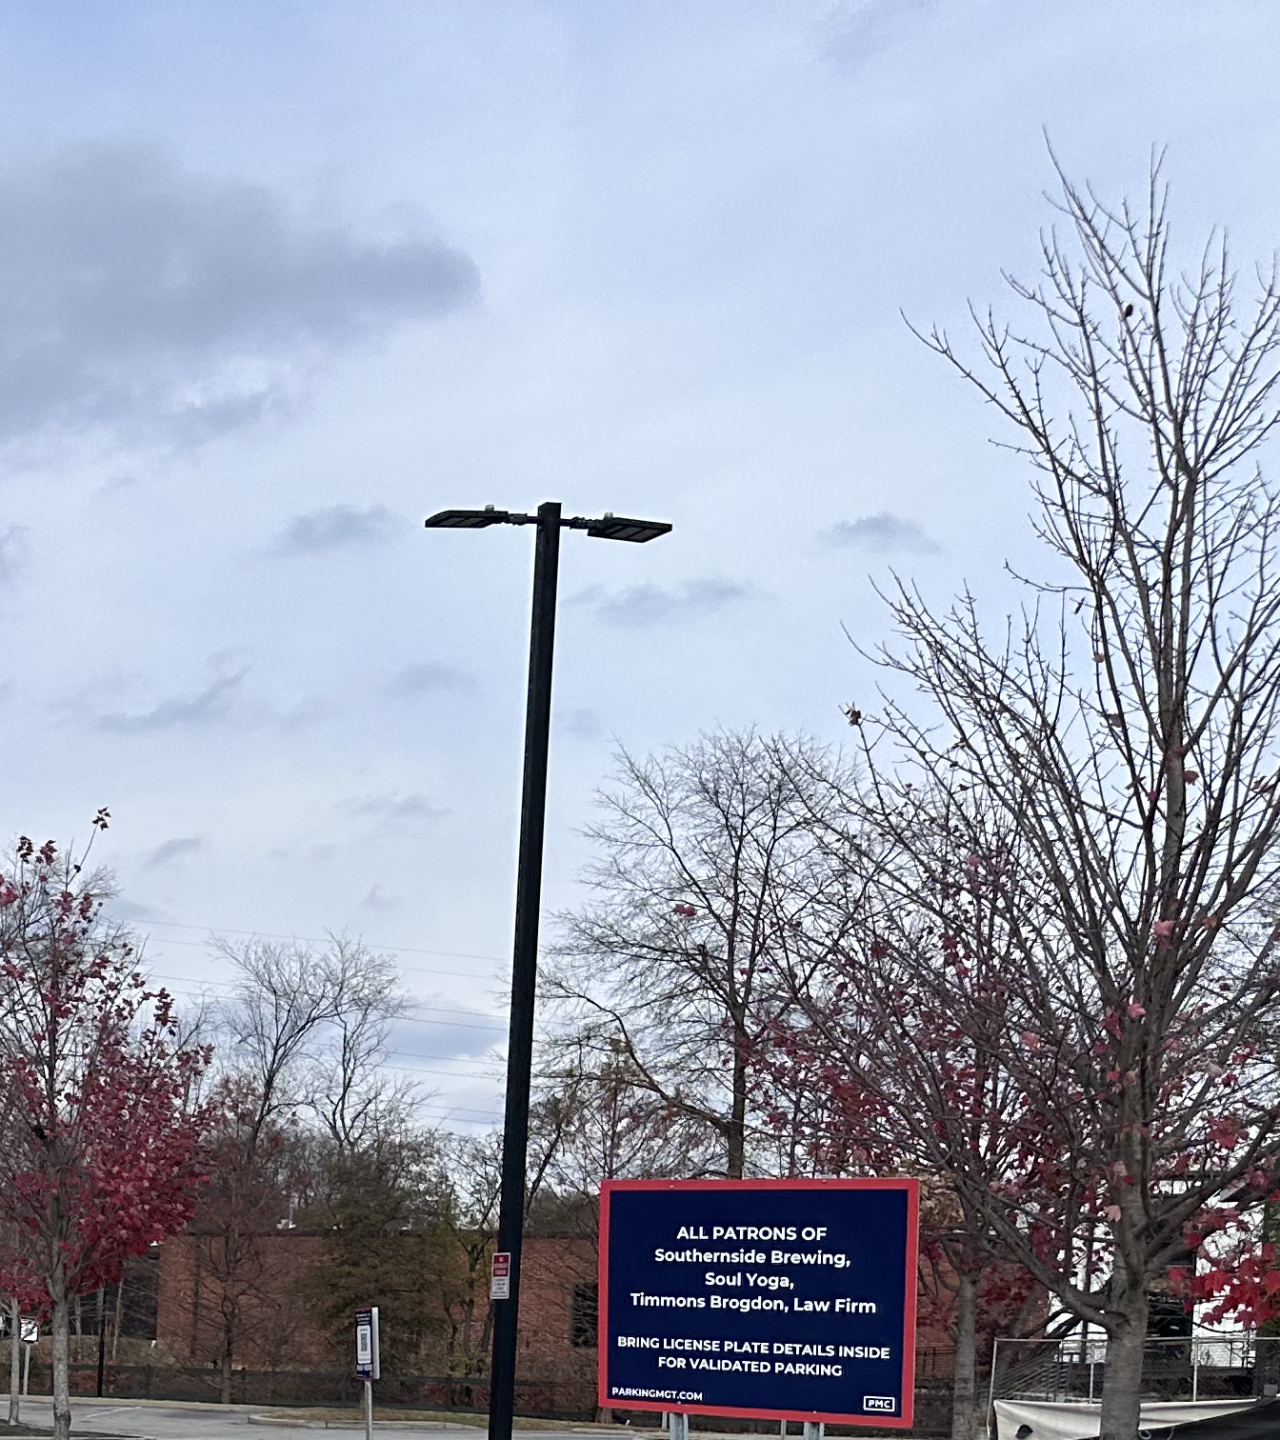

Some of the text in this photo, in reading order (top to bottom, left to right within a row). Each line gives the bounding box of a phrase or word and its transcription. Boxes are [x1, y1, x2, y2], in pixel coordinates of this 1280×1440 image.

[676, 1226, 828, 1241] ALL PATRONS OF
[654, 1248, 851, 1269] Southernside Brewing,
[704, 1271, 795, 1291] Soul Yoga,
[629, 1291, 877, 1314] Timmons Brogdon, Law Firm
[617, 1335, 891, 1360] BRING LICENSE PLATE DETAILS INSIDE
[658, 1356, 843, 1377] FOR VALIDATED PARKING
[611, 1386, 703, 1402] PARKINGMGT.COM
[867, 1398, 892, 1410] PMC
